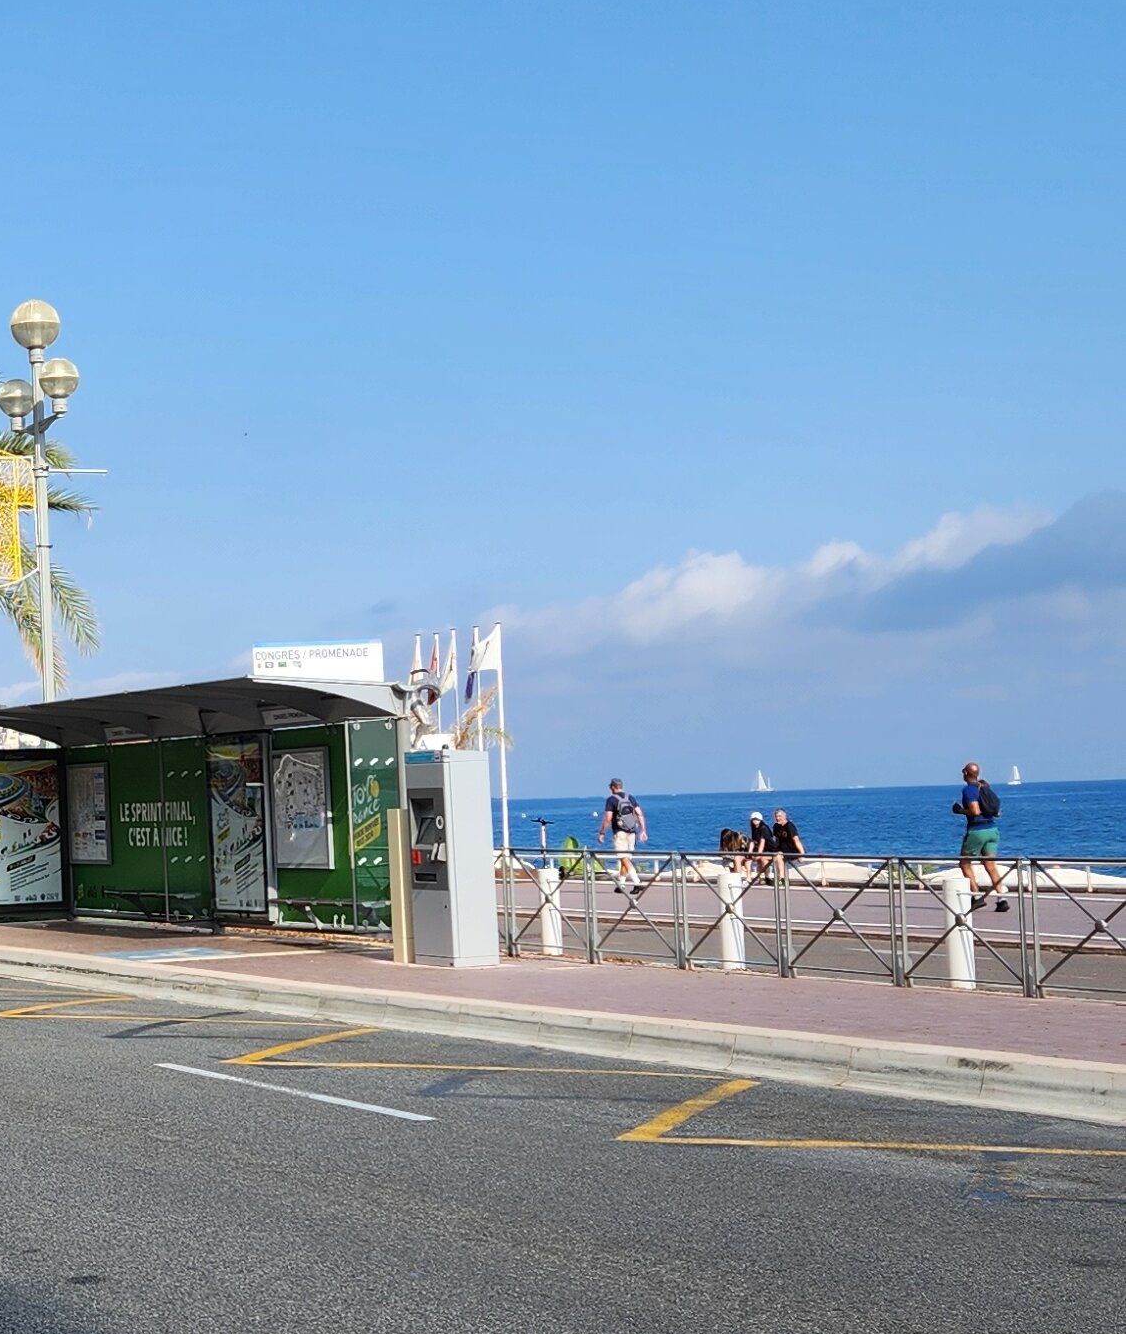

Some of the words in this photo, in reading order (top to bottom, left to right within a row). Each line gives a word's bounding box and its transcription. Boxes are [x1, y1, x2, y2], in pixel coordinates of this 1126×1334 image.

[255, 650, 300, 661] CONGRES
[309, 647, 369, 659] PROMENADE
[119, 802, 130, 822] LE
[131, 802, 162, 822] SPRINT
[165, 800, 195, 825] FINAL,
[128, 827, 151, 847] C'EST
[153, 823, 160, 847] À
